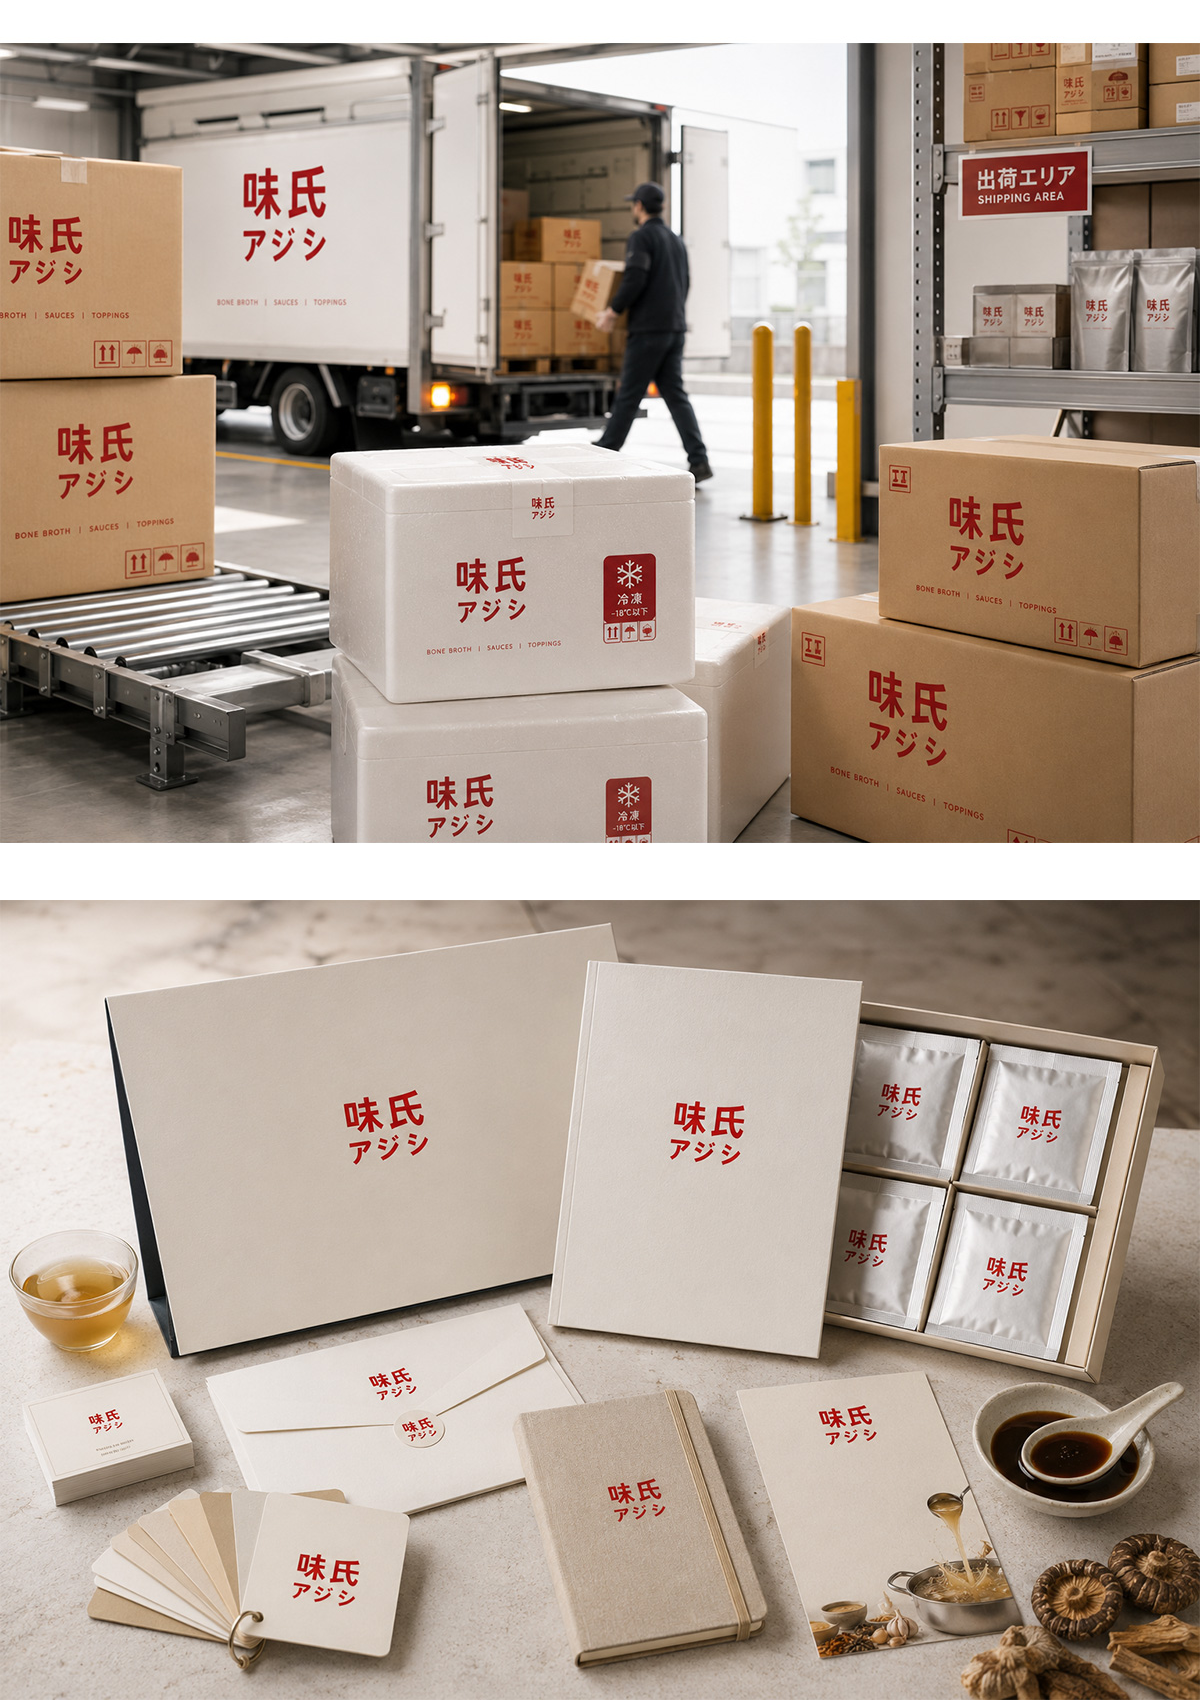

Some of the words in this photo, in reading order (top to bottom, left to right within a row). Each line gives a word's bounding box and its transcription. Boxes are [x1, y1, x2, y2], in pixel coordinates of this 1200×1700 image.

[977, 165, 1076, 191] 出荷エリア
[243, 165, 327, 220] 味氏
[978, 193, 1031, 205] SHIPPING
[1034, 191, 1064, 202] AREA
[9, 214, 83, 255] 味氏
[243, 227, 327, 262] アジシ
[9, 259, 83, 285] アジシ
[1086, 299, 1108, 312] 味氏
[1086, 313, 1108, 322] アジシ
[1147, 313, 1170, 322] アジシ
[58, 422, 134, 465] 味氏
[58, 470, 134, 499] アジシ
[532, 497, 555, 509] 味氏
[532, 511, 555, 520] アジシ
[15, 531, 39, 540] BONE
[42, 527, 71, 537] BROTH
[89, 523, 120, 533] SAUCES
[137, 517, 175, 528] TOPPINGS
[949, 496, 1024, 546] 味氏
[457, 556, 526, 594] 味氏
[950, 545, 1024, 580] アジシ
[458, 599, 526, 623] アジシ
[915, 585, 934, 594] BONE
[937, 588, 960, 597] BROTH
[975, 594, 1003, 605] SAUCES
[1019, 601, 1057, 614] TOPPINGS
[869, 670, 947, 732] 味氏
[869, 722, 947, 766] アジシ
[427, 774, 494, 810] 味氏
[830, 766, 851, 779] BONE
[854, 773, 879, 787] BROTH
[896, 787, 926, 802] SAUCES
[943, 801, 984, 821] TOPPINGS
[427, 814, 494, 838] アジシ
[881, 1083, 922, 1107] 味氏
[343, 1089, 425, 1133] 味氏
[673, 1101, 745, 1139] 味氏
[877, 1104, 918, 1121] アジシ
[1020, 1105, 1063, 1130] 味氏
[1016, 1126, 1058, 1144] アジシ
[349, 1132, 429, 1165] アジシ
[669, 1138, 741, 1166] アジシ
[848, 1229, 888, 1254] 味氏
[843, 1250, 884, 1267] アジシ
[986, 1257, 1029, 1282] 味氏
[982, 1277, 1024, 1297] アジシ
[818, 1405, 873, 1429] 味氏
[408, 1430, 437, 1442] アジシ
[825, 1429, 877, 1446] アジシ
[608, 1478, 662, 1506] 味氏
[613, 1502, 667, 1523] アジシ
[297, 1553, 360, 1587] 味氏
[292, 1582, 356, 1607] アジシ
